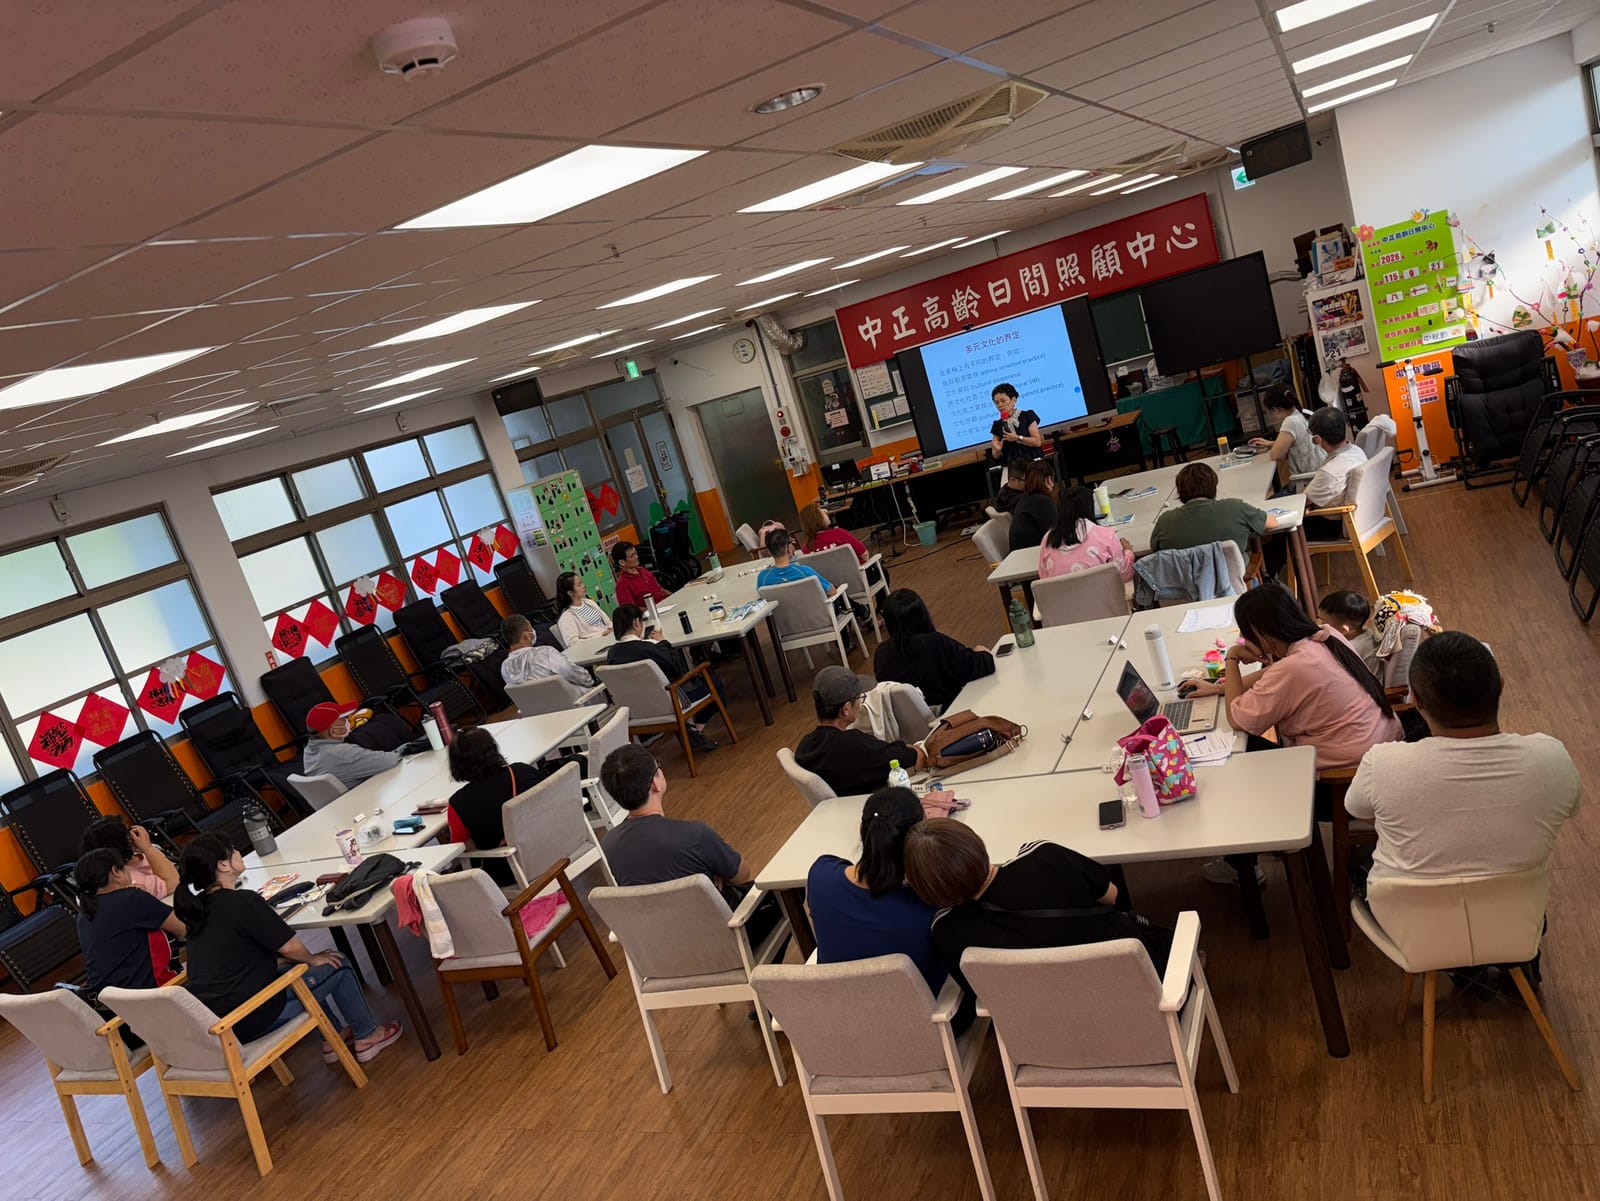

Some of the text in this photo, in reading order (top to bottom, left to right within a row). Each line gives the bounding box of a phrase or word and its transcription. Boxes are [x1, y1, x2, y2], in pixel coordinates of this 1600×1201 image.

[1381, 252, 1400, 263] 2026
[1384, 274, 1399, 283] 115
[1430, 262, 1441, 271] 21
[857, 221, 1200, 351] 中正高齡日間照顧中心
[965, 330, 1021, 353] 多元文化的界定
